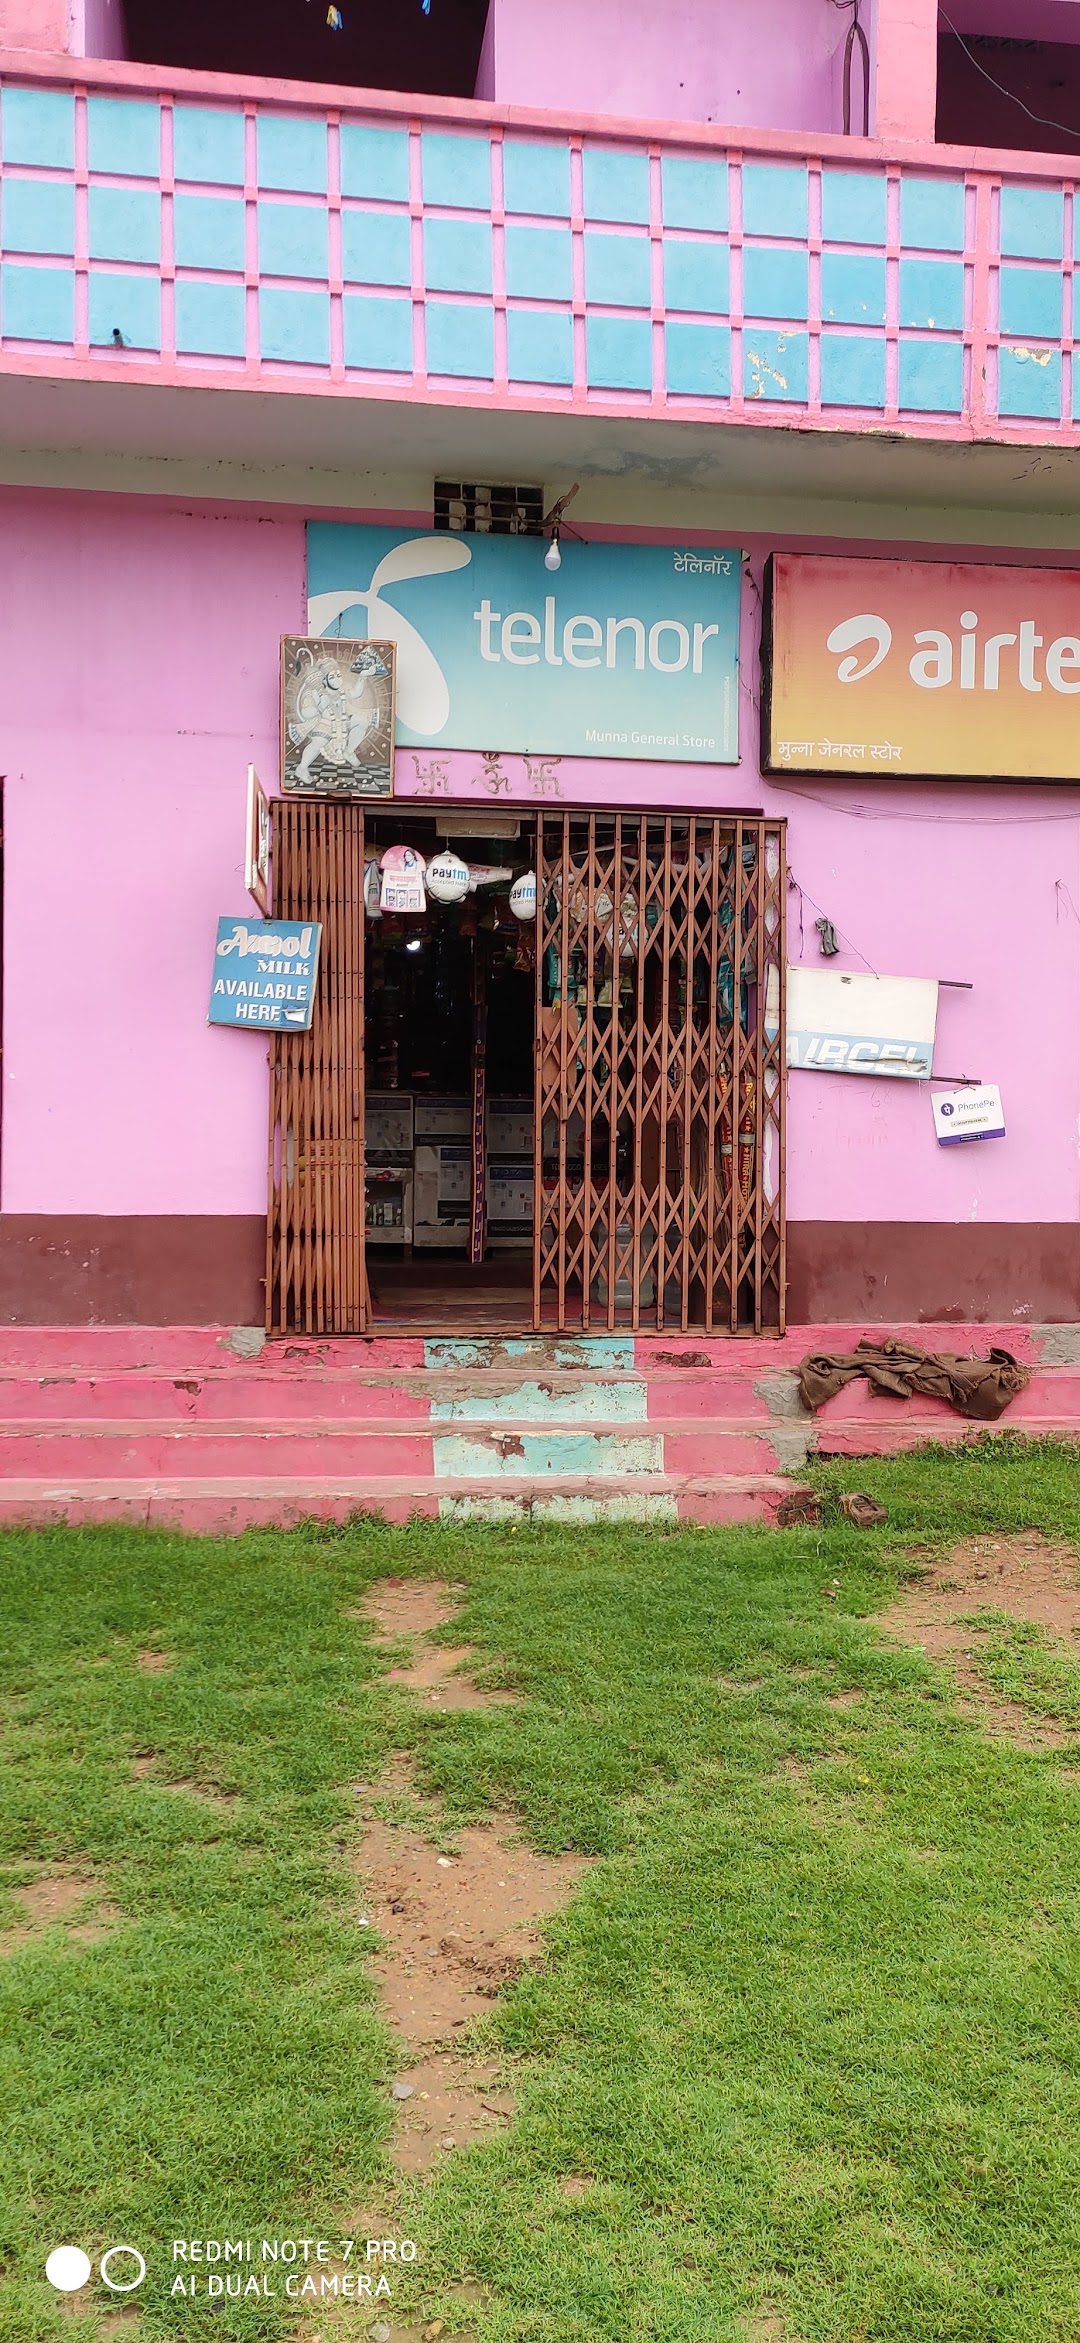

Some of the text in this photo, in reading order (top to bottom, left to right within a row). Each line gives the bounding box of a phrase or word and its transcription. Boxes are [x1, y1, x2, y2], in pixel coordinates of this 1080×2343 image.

[473, 596, 720, 674] telenor
[585, 730, 715, 749] Munna General Store
[778, 737, 904, 761] मुन्ना जेनरल स्टोर
[255, 959, 312, 976] MILK
[213, 979, 308, 1001] AVAILABLE
[236, 1003, 282, 1022] HERE
[957, 1099, 995, 1113] PhonePe
